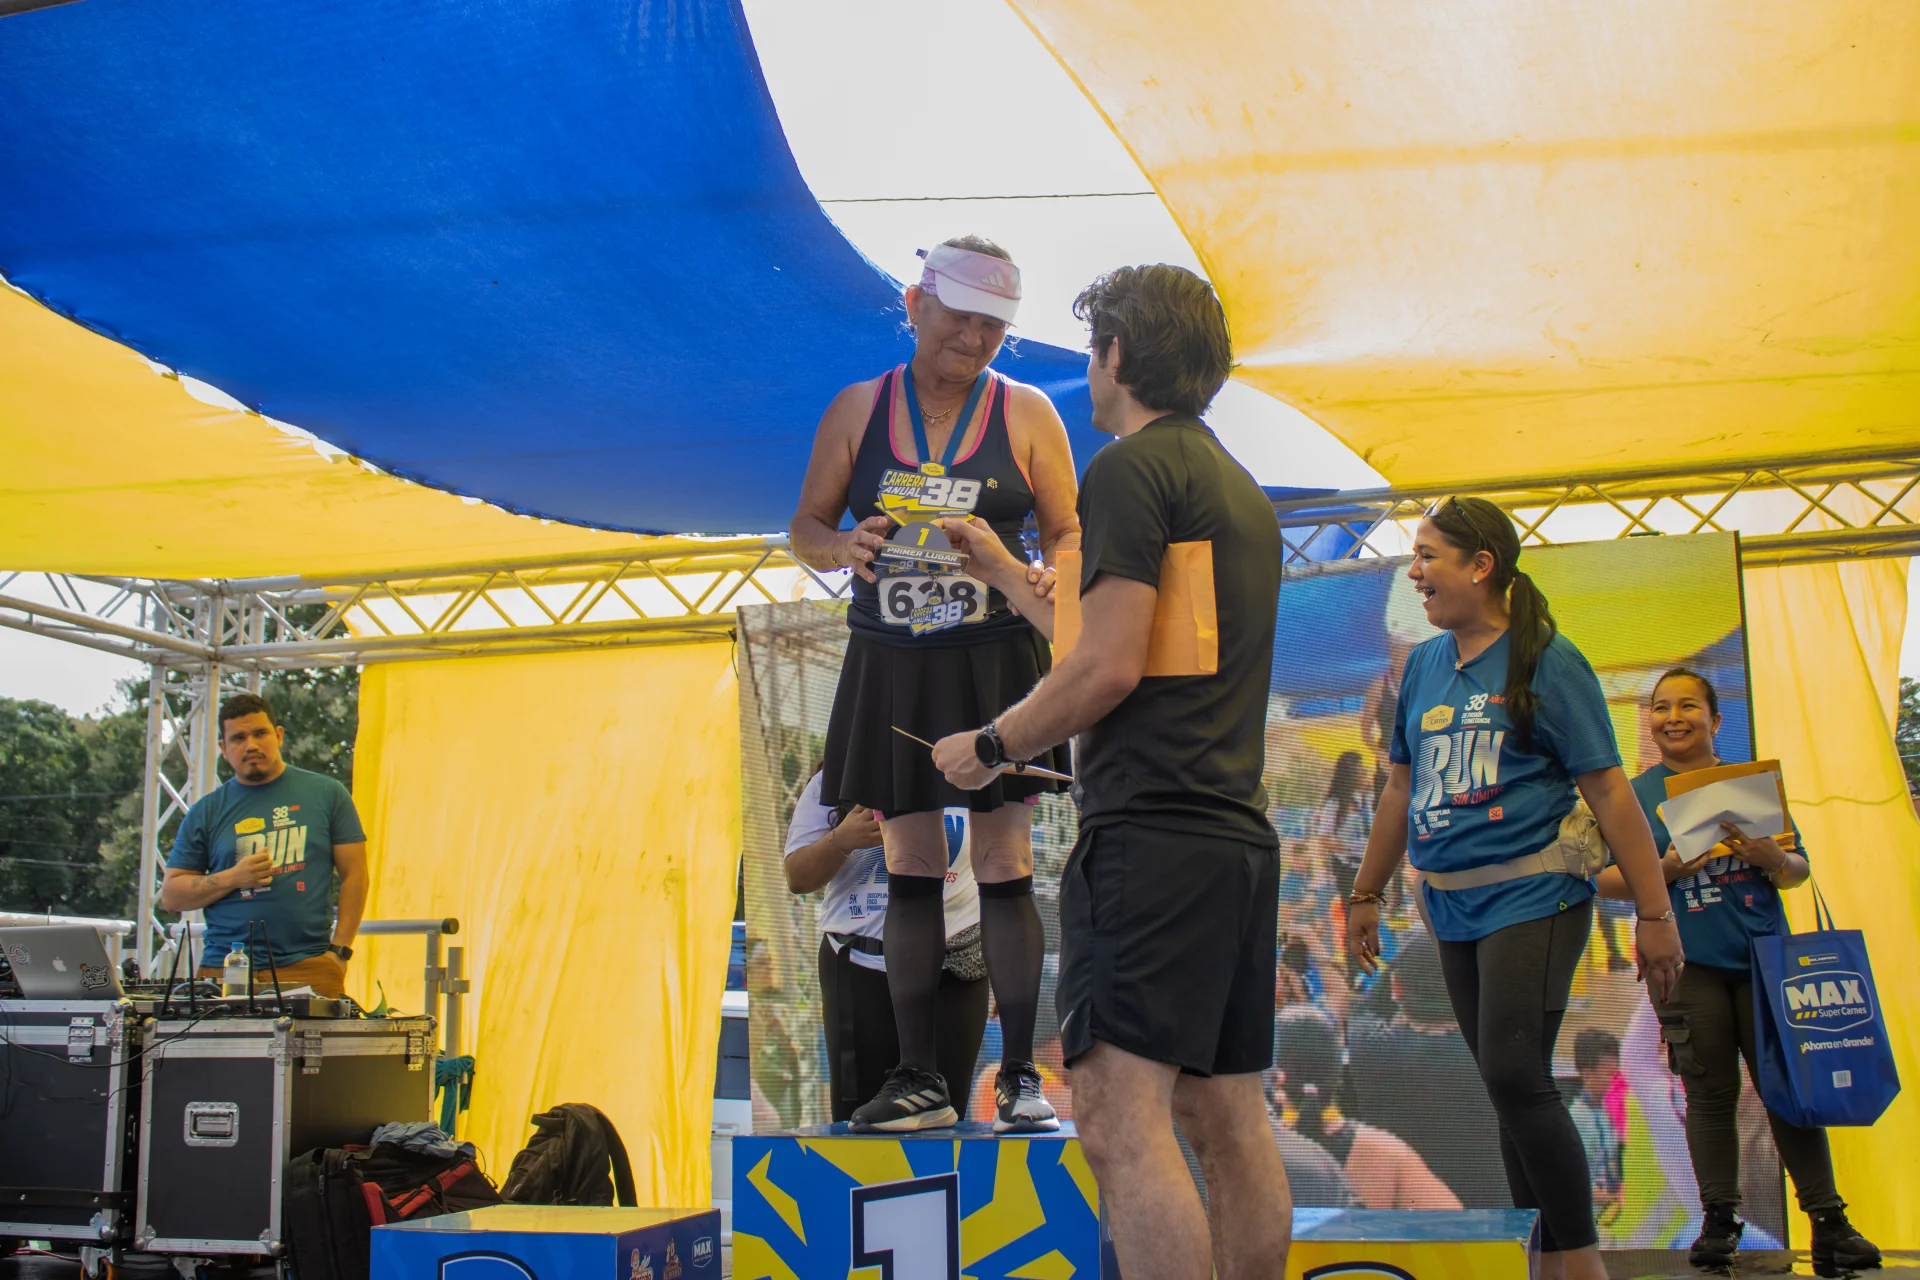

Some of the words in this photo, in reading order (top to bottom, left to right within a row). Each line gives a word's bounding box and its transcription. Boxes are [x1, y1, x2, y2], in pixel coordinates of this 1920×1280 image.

[882, 470, 927, 488] CARRERA
[882, 486, 921, 497] ANUAL
[919, 476, 982, 509] 38
[917, 527, 930, 546] 1
[886, 547, 923, 557] PRIMER
[925, 551, 958, 562] LUGAR
[912, 614, 932, 625] ANUAL
[931, 600, 963, 625] 38
[1464, 692, 1489, 711] 38
[1411, 730, 1505, 812] RUN
[1451, 793, 1470, 806] SIN
[1470, 786, 1505, 804] LÍMITES
[272, 805, 289, 820] 38
[1413, 813, 1422, 825] 5K
[1416, 824, 1429, 835] 10K
[849, 893, 858, 905] 5K
[1684, 890, 1694, 899] 5K
[849, 905, 863, 916] 10K
[1686, 898, 1700, 908] 10K
[1785, 980, 1864, 1010] MAX
[1833, 1040, 1843, 1048] en
[1843, 1036, 1874, 1047] Grande!
[693, 1240, 712, 1258] MAX
